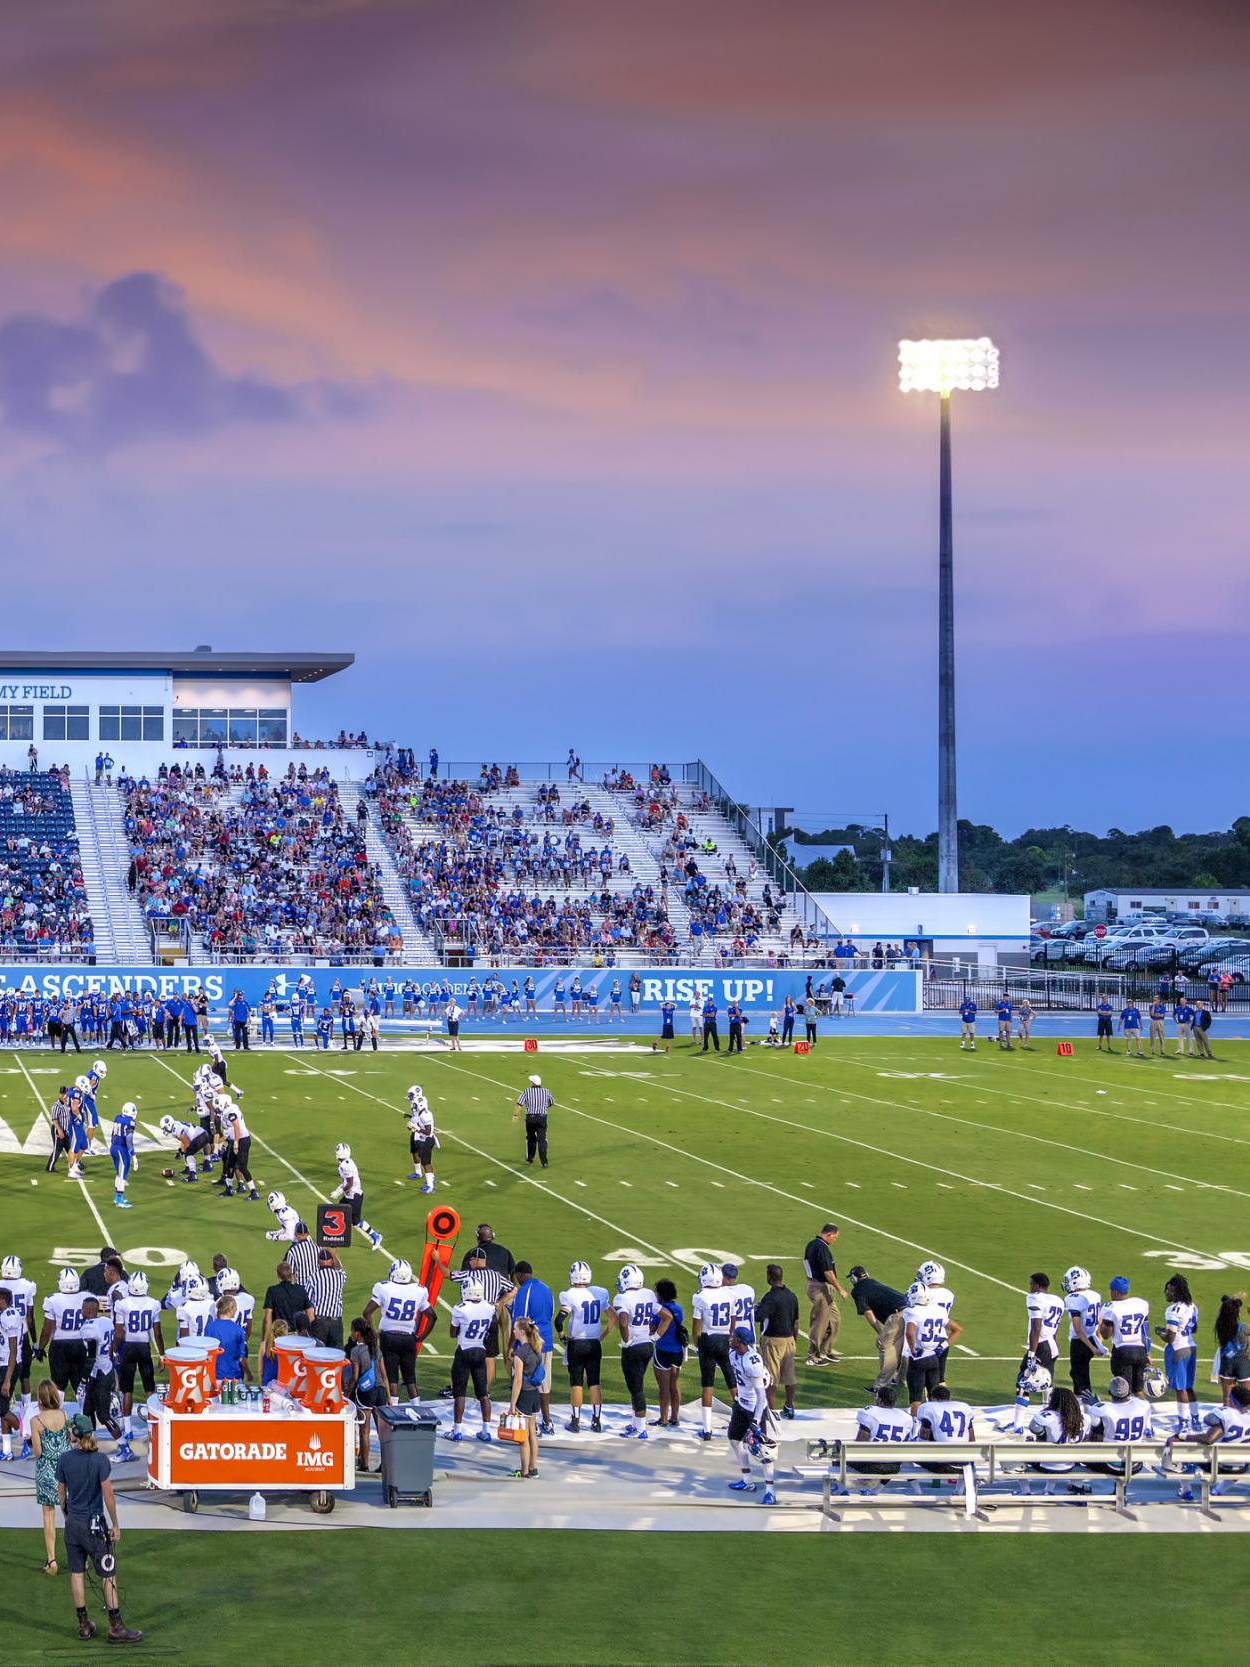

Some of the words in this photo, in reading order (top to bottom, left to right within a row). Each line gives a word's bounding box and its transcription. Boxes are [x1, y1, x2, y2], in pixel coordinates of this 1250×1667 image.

[22, 685, 72, 699] FIELD
[20, 975, 223, 1001] ASCENDERS
[642, 978, 713, 1002] RISE
[722, 978, 774, 1002] UP!
[526, 1039, 538, 1050] 30
[798, 1041, 810, 1052] 20
[1060, 1042, 1072, 1053] 10
[322, 1210, 347, 1237] 3
[48, 1247, 189, 1267] 50
[601, 1248, 746, 1267] 40
[385, 1297, 416, 1322] 58
[581, 1299, 601, 1325] 10
[710, 1302, 731, 1327] 13
[128, 1309, 153, 1333] 80
[1119, 1312, 1145, 1336] 57
[293, 1359, 307, 1377] G
[181, 1369, 197, 1389] G
[320, 1369, 336, 1389] G
[876, 1423, 903, 1442] 55
[938, 1410, 966, 1438] 47
[1114, 1416, 1145, 1441] 99
[179, 1442, 287, 1461] GATORADE
[296, 1451, 334, 1467] IMG
